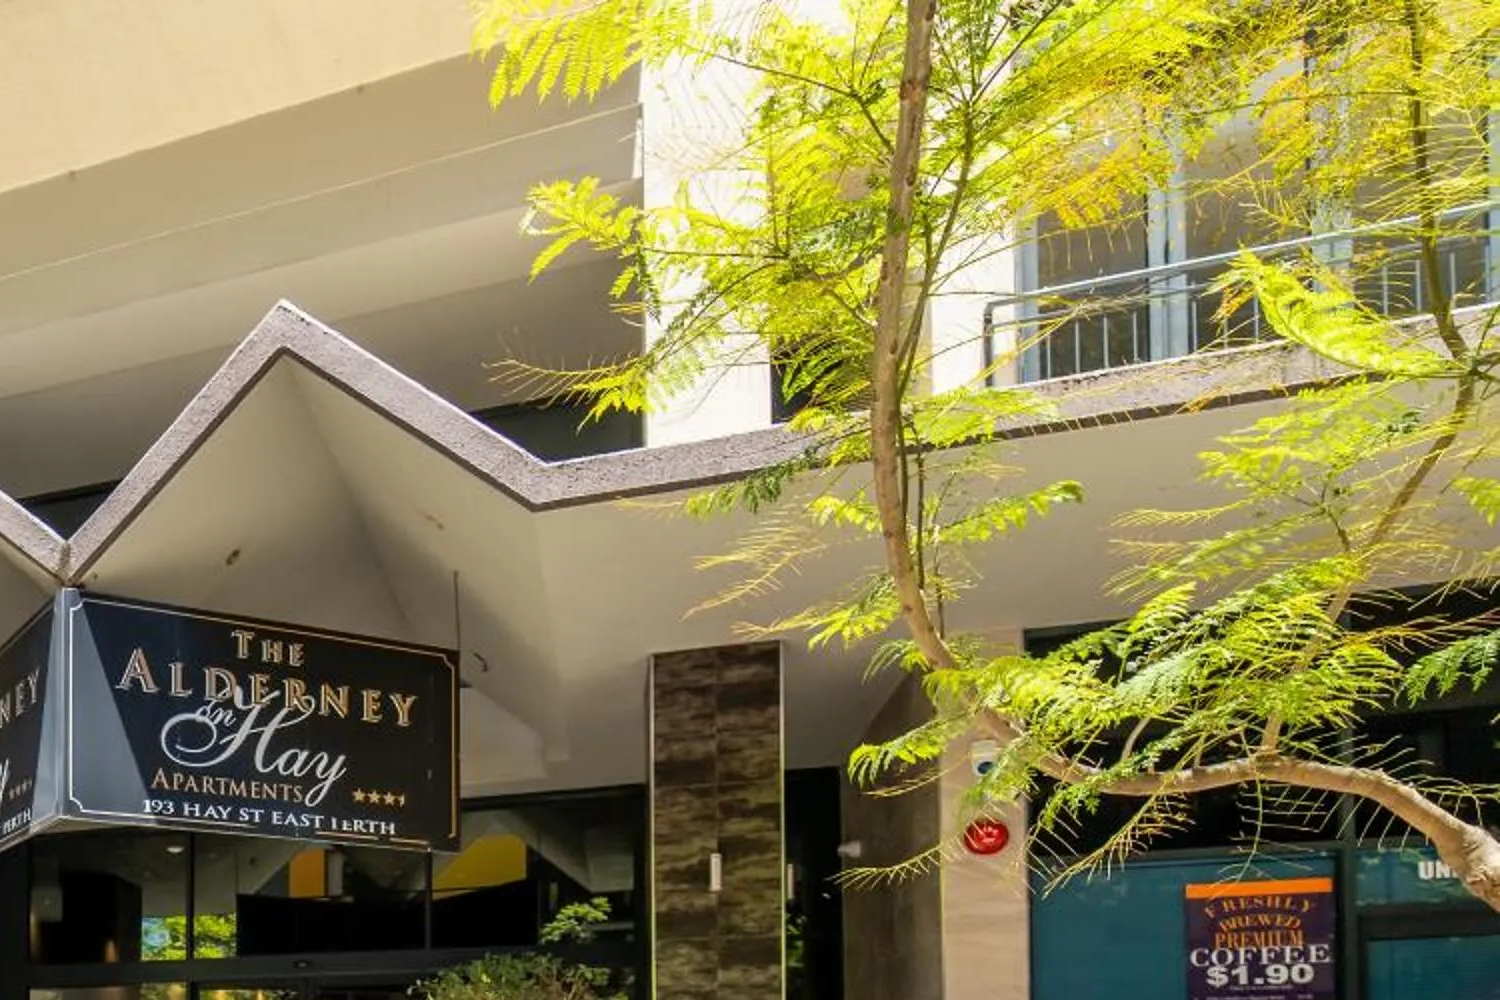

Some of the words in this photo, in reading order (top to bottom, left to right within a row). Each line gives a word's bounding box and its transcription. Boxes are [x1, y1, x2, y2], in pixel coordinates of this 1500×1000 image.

[231, 628, 306, 667] THE
[115, 647, 419, 728] ALDERNEY
[160, 684, 348, 807] Hay
[151, 767, 303, 804] APARTMENTS
[143, 799, 175, 815] 193
[183, 802, 232, 820] HAY
[239, 807, 265, 823] ST
[271, 810, 325, 829] EAST
[1189, 943, 1331, 968] COFFEE
[1214, 930, 1305, 949] PREMIUM
[1205, 963, 1315, 988] $1.90
